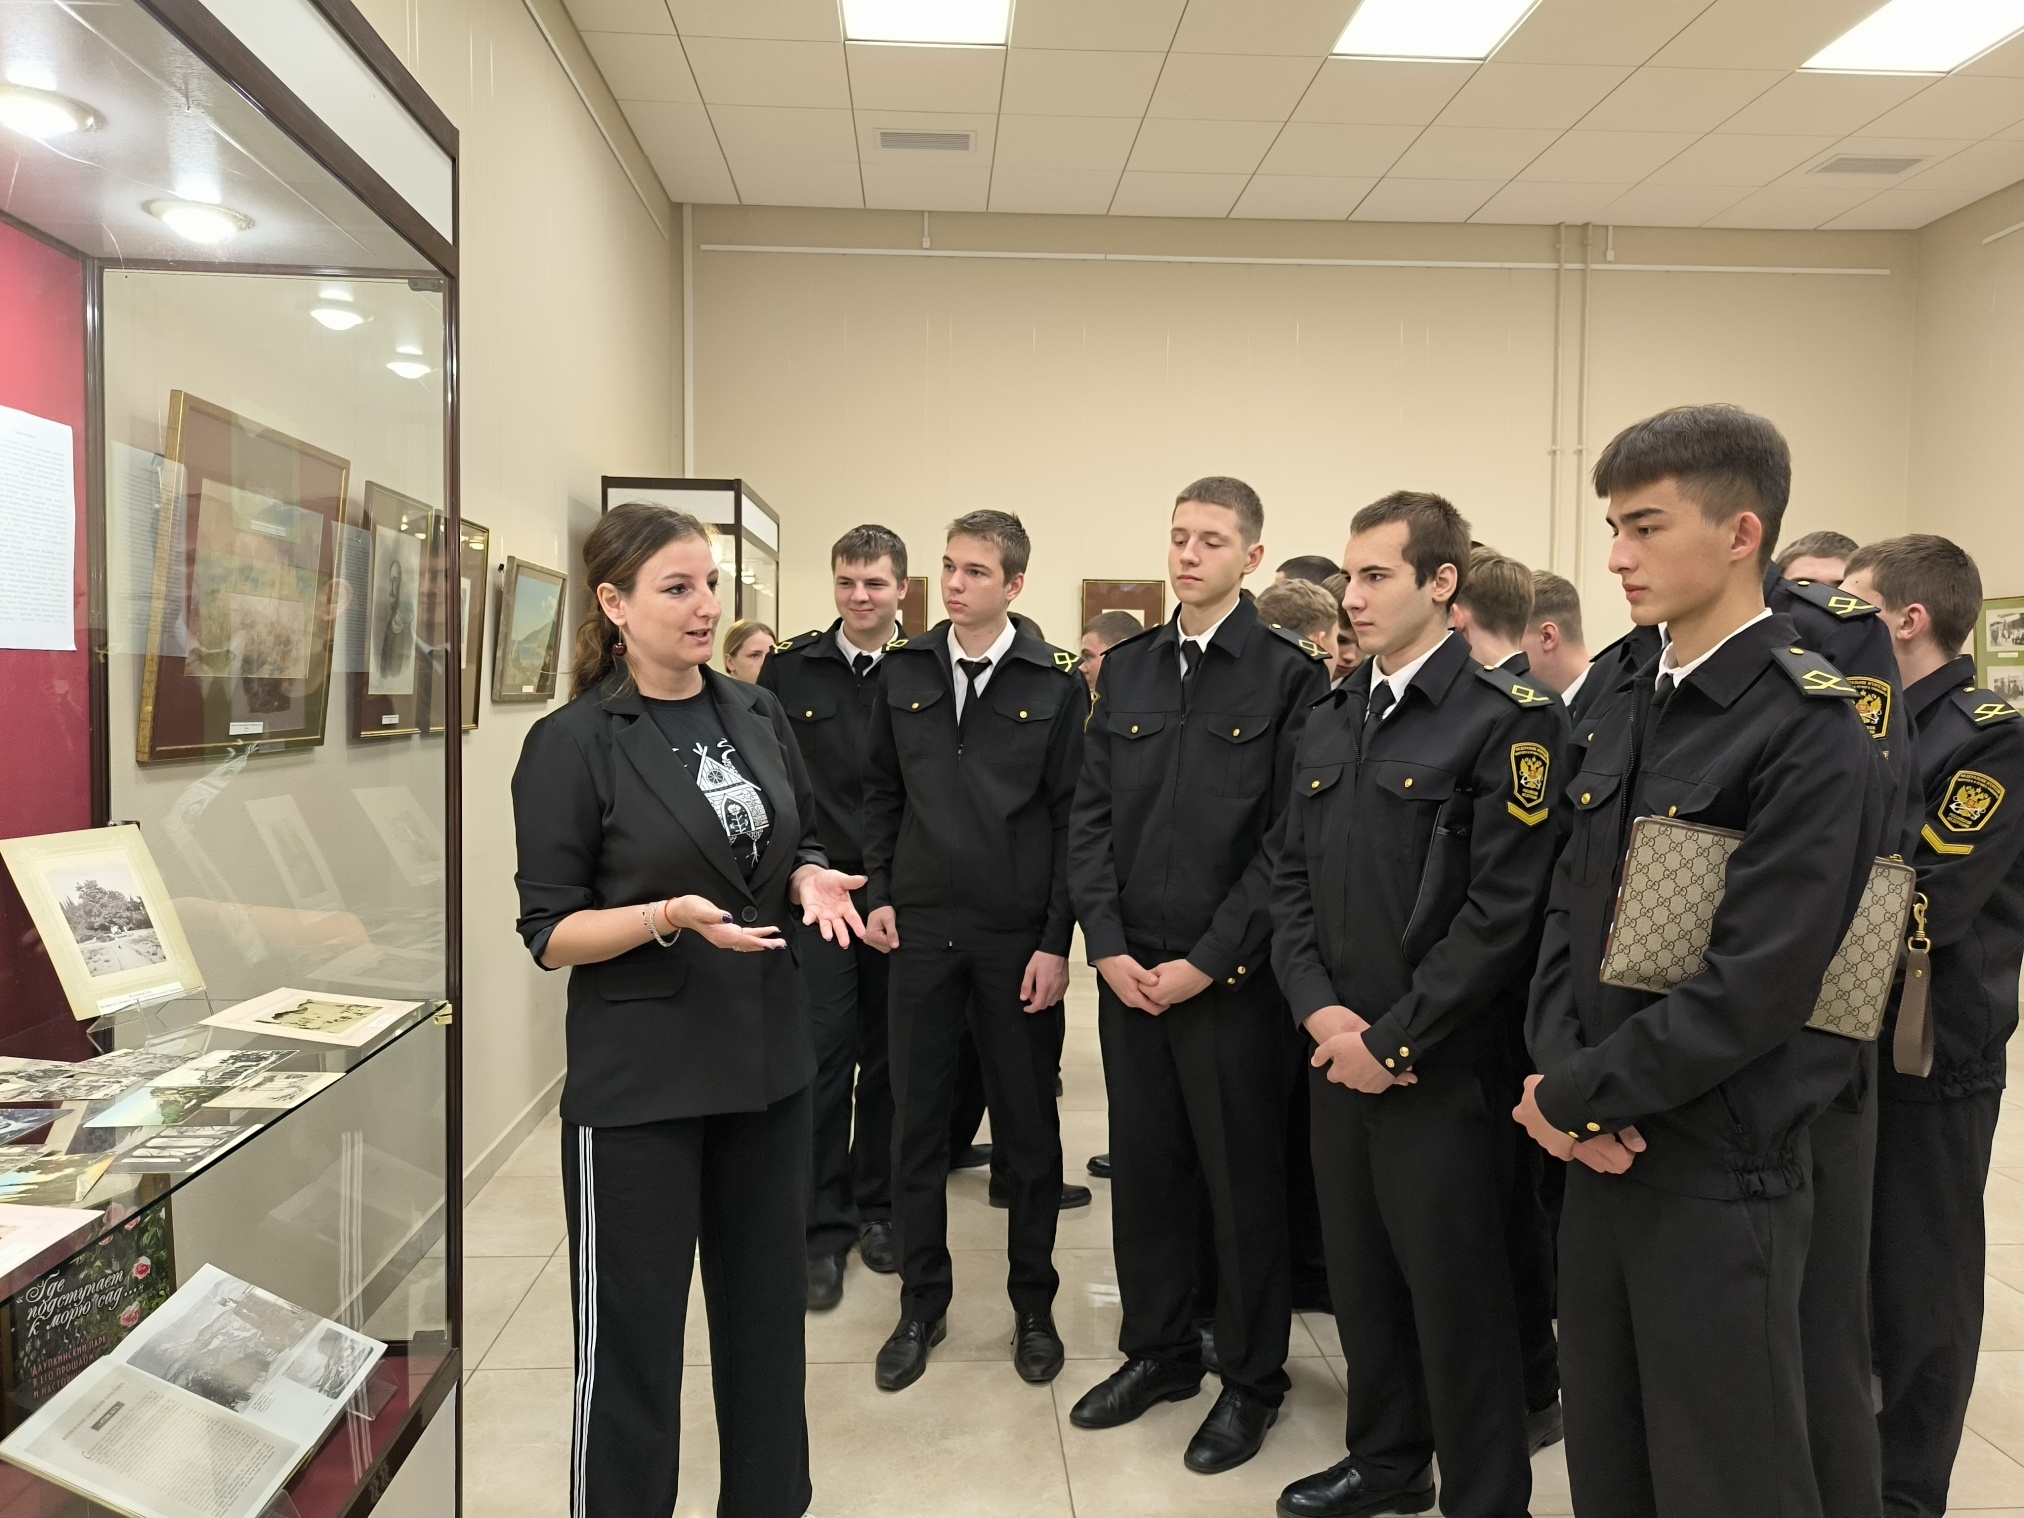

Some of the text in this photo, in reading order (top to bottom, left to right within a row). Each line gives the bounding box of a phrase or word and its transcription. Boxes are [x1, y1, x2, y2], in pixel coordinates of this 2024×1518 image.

[27, 1270, 124, 1320] подступает
[46, 1301, 91, 1330] морю
[89, 1335, 107, 1350] ПАРК
[32, 1352, 95, 1388] В ЕГО ПРОШЛОМ
[33, 1390, 39, 1400] И
